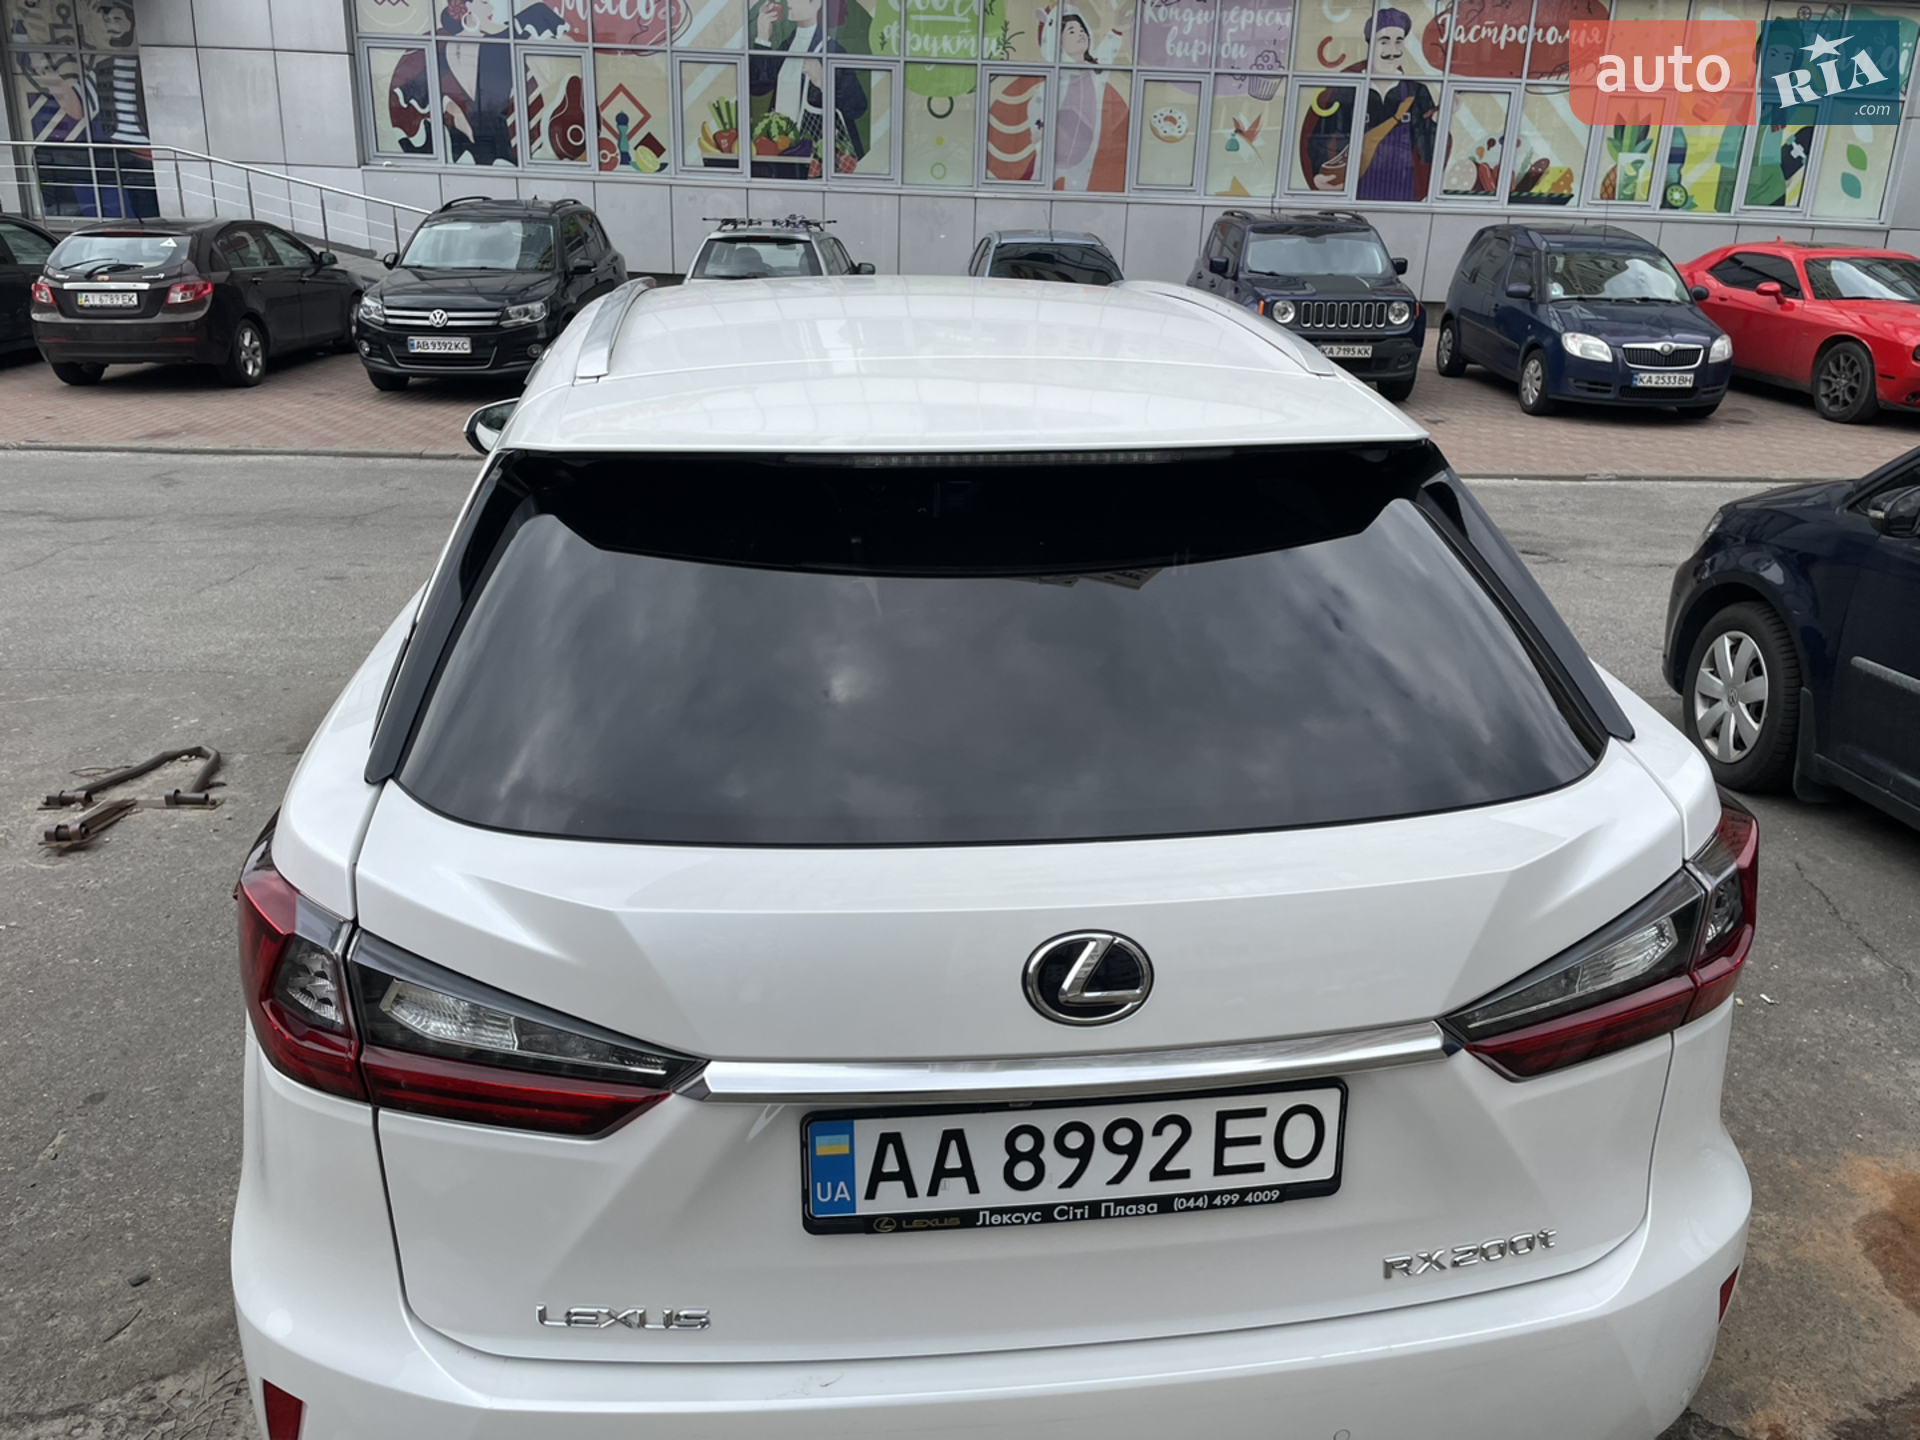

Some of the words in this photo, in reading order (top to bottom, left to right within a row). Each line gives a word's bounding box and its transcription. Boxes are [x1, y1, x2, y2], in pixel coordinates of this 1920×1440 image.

[415, 339, 429, 350] AB
[1336, 347, 1356, 356] 7195
[864, 1128, 981, 1200] AA
[1003, 1114, 1192, 1191] 8992
[1213, 1103, 1326, 1176] EO
[816, 1181, 851, 1202] UA
[976, 1210, 1042, 1226] Лексус
[1053, 1205, 1089, 1221] Сіті
[1101, 1202, 1158, 1217] Плаза
[1173, 1195, 1208, 1211] (044)
[1212, 1193, 1240, 1206] 499
[1244, 1189, 1280, 1203] 4009
[902, 1217, 961, 1229] LEXUS
[535, 1303, 711, 1330] LEXUS
